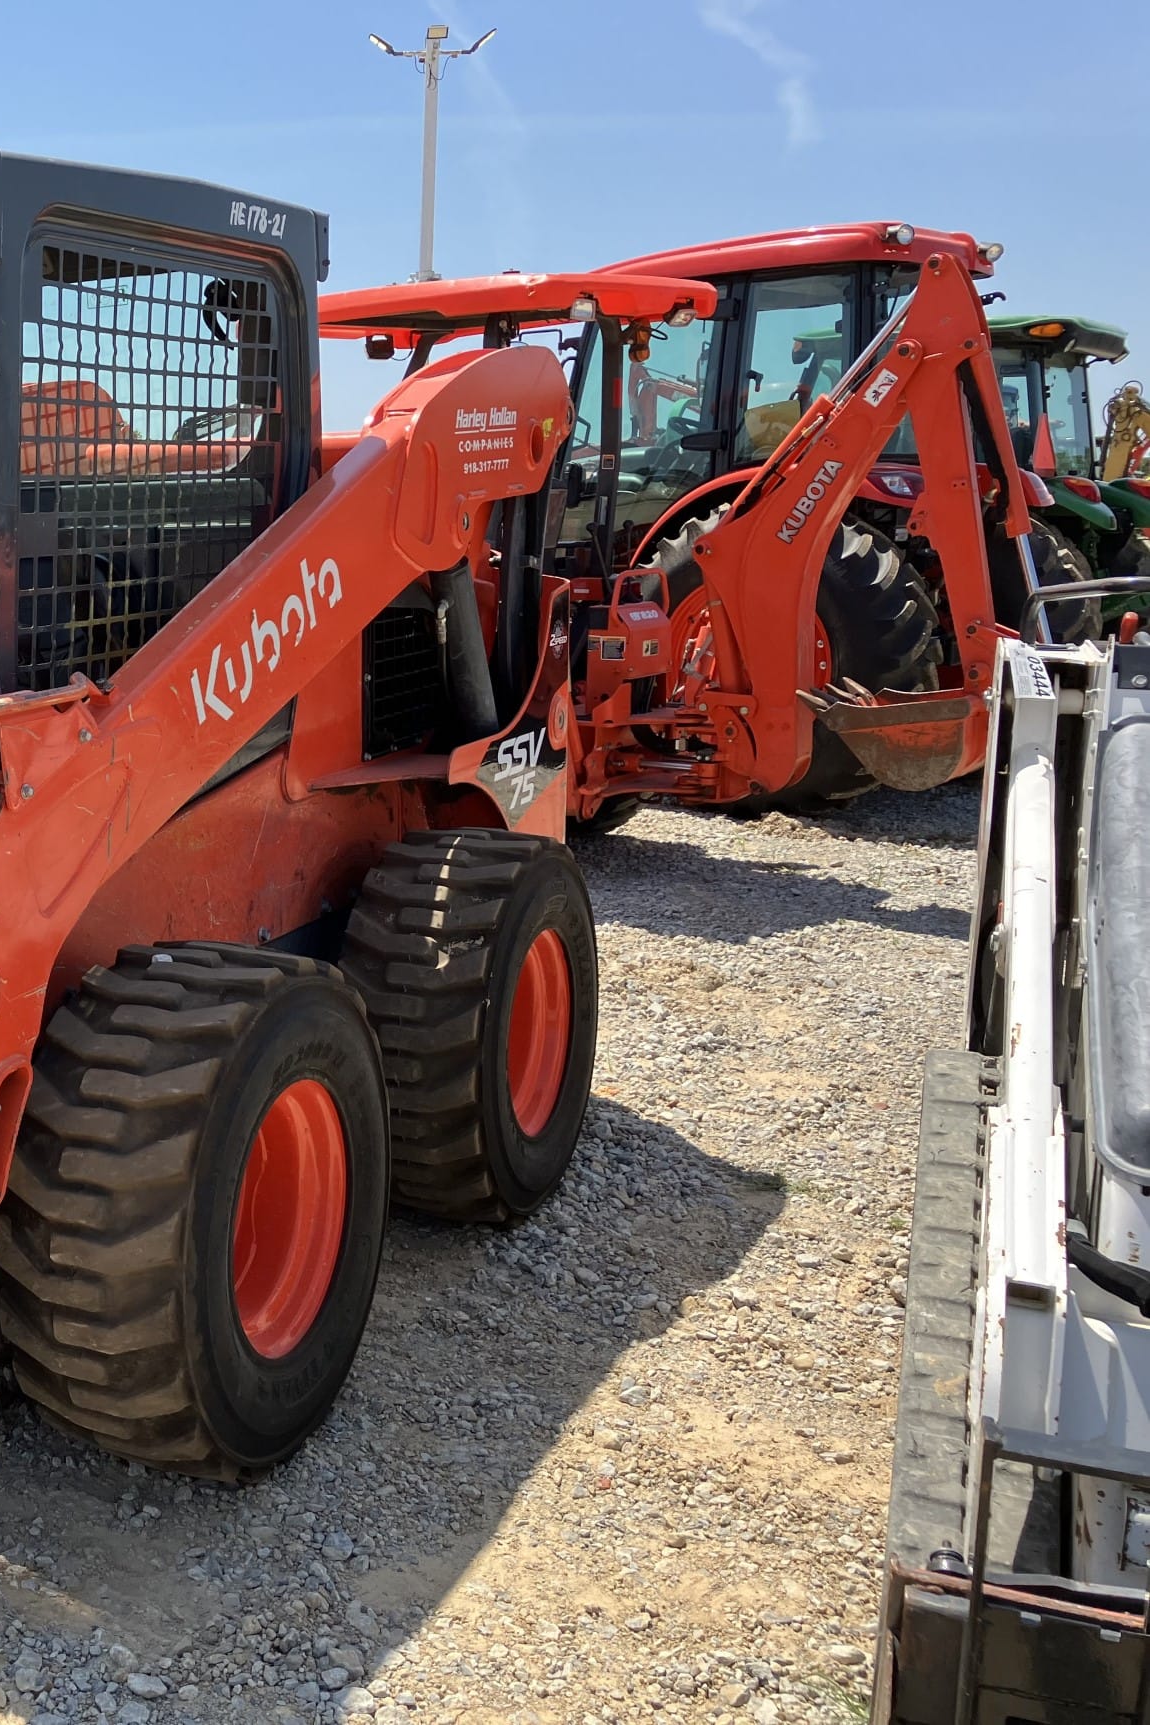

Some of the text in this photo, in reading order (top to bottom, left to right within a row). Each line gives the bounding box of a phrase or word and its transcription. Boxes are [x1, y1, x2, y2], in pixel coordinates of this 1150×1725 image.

[455, 406, 517, 432] Harley Hollan
[776, 460, 843, 544] KUBOTA
[190, 558, 343, 726] Kubota
[1027, 656, 1051, 697] 03444
[493, 726, 547, 782] SSV
[509, 770, 536, 810] 75
